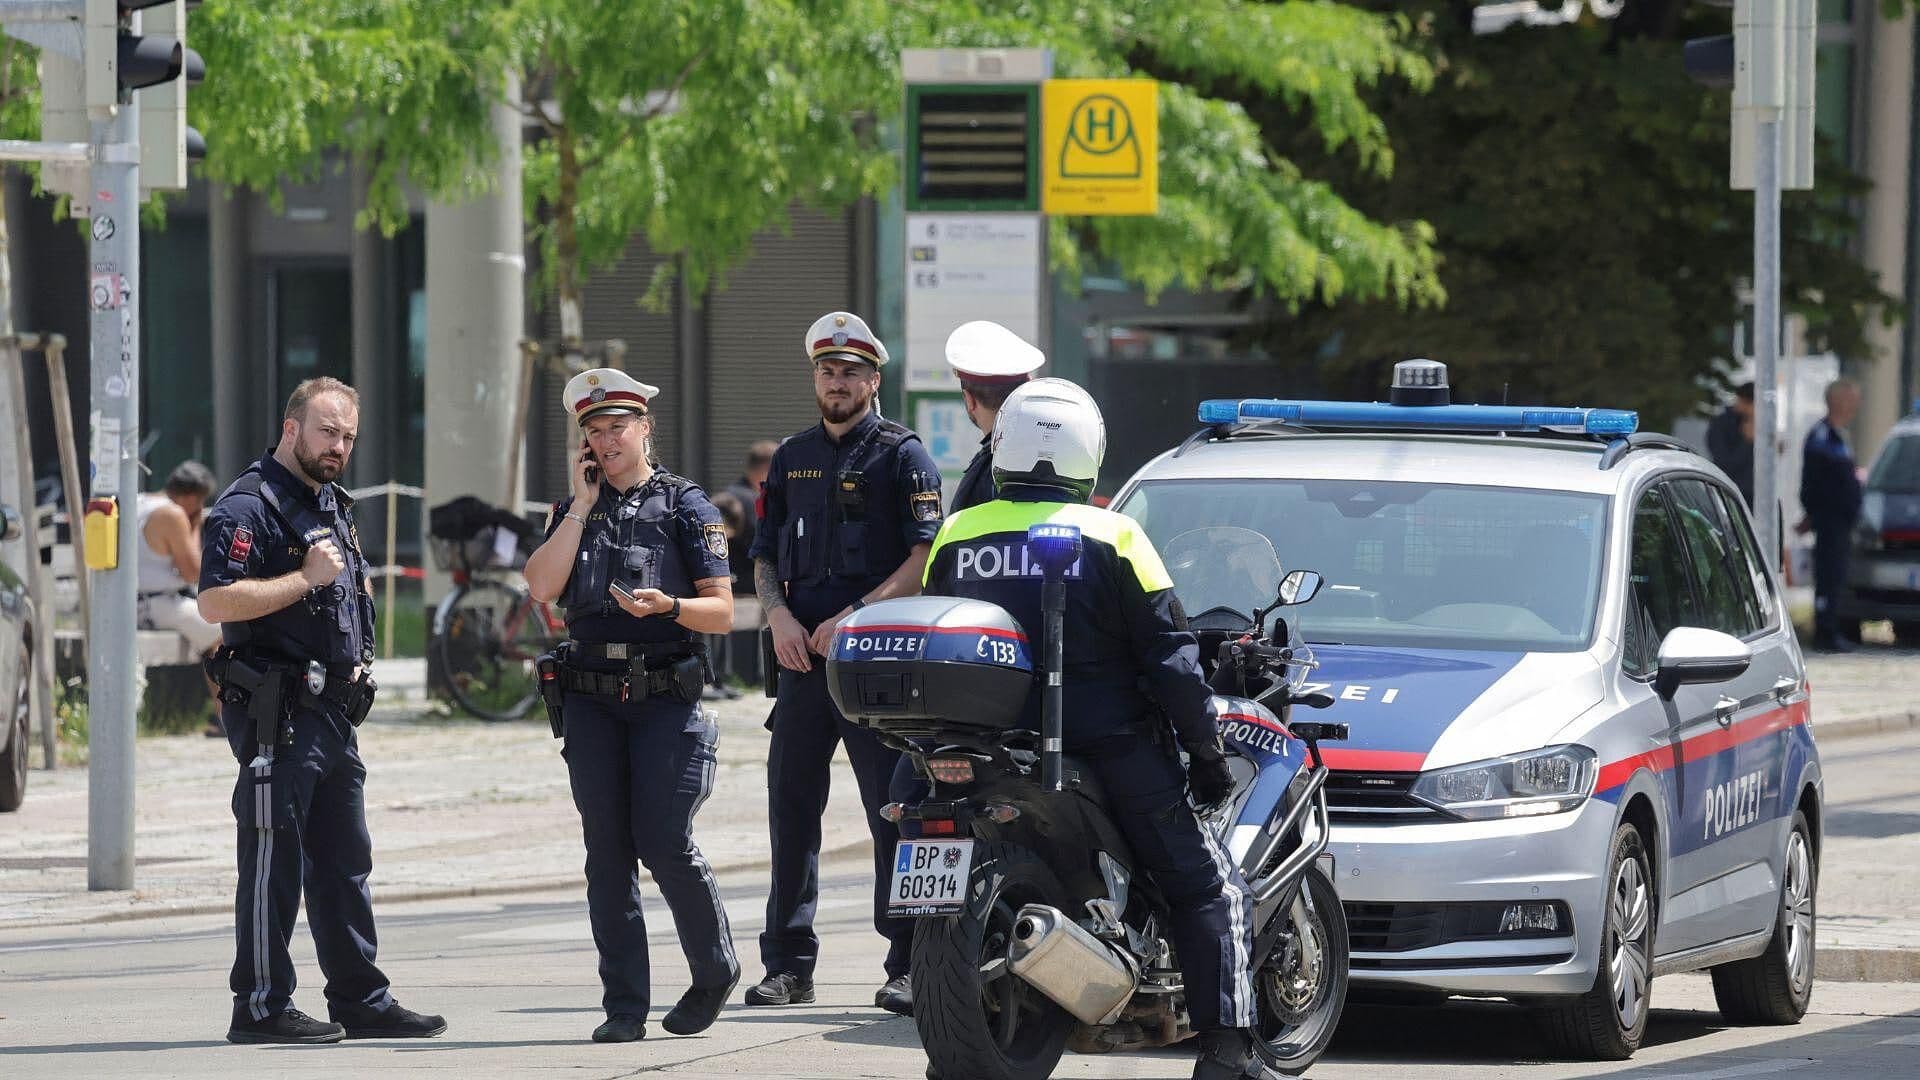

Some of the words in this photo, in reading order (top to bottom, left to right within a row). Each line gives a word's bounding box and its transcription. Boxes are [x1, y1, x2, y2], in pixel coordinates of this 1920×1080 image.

[1087, 108, 1114, 142] H
[787, 470, 822, 480] POLIZEI
[957, 545, 1080, 579] POLII
[845, 637, 926, 652] POLIZEI
[990, 640, 1016, 665] 133
[1224, 721, 1289, 757] POLIZEI
[1704, 770, 1761, 840] POLIZEI
[901, 862, 908, 870] A
[915, 846, 939, 869] BP
[900, 874, 957, 899] 60314
